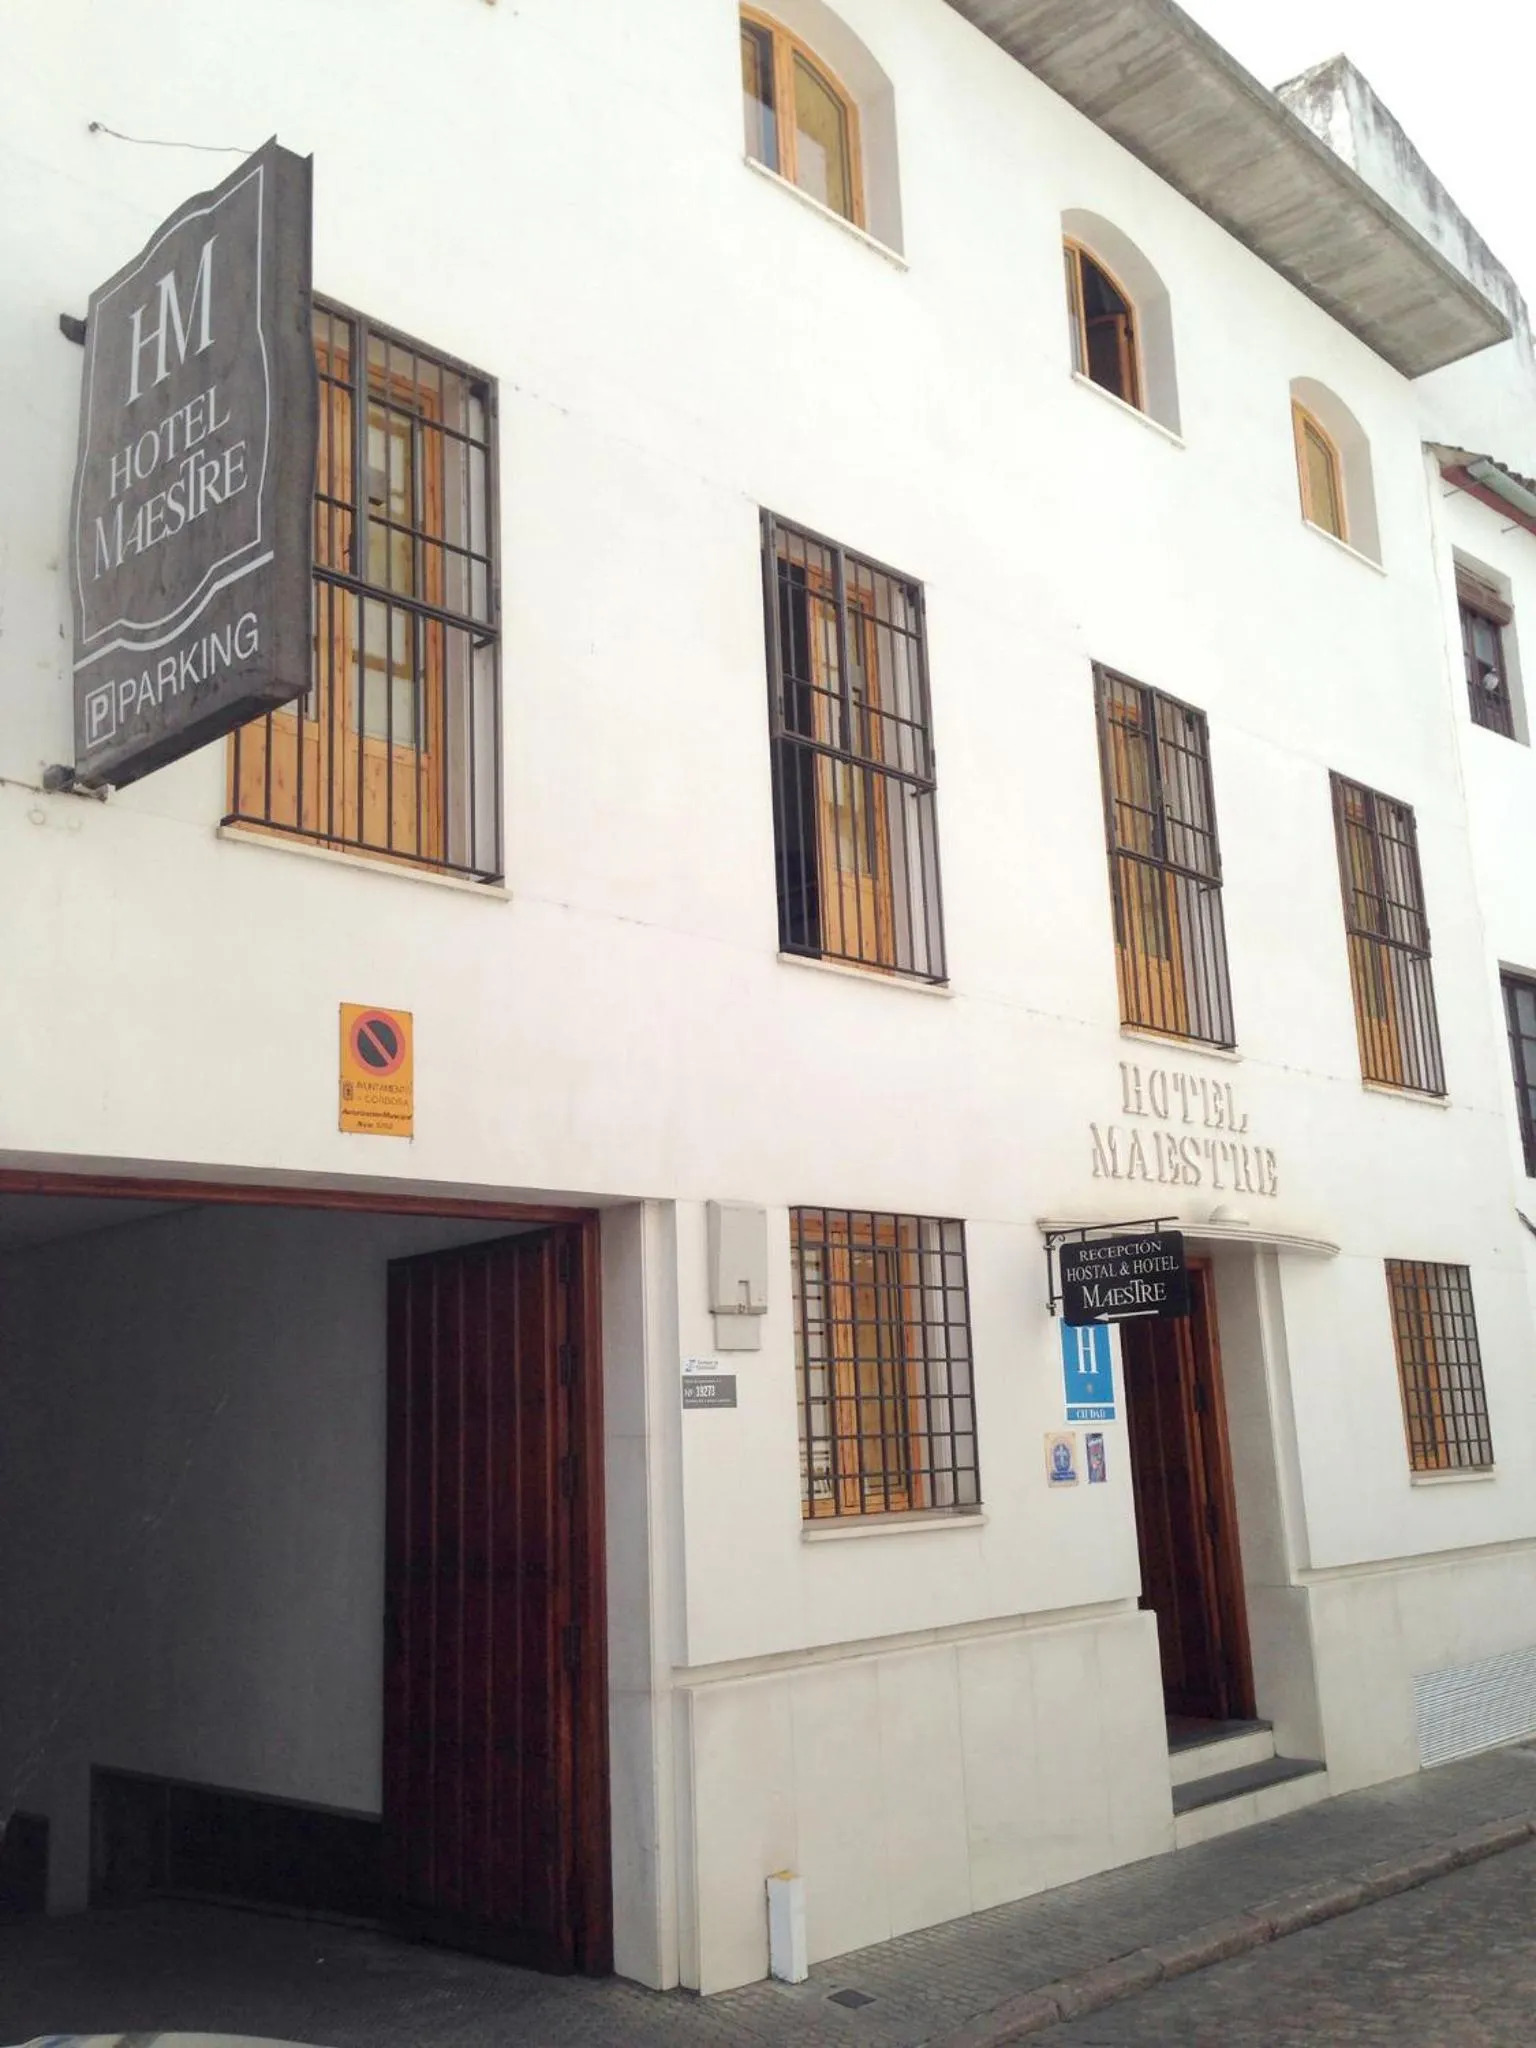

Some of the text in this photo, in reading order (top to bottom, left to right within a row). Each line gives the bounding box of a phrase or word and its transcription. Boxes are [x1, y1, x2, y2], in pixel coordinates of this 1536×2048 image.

[124, 234, 219, 407] HM
[110, 385, 231, 500] HOTEL
[92, 441, 248, 580] MAESTRE
[91, 612, 258, 738] P PARKING
[1119, 1061, 1249, 1133] HOTEL
[1089, 1122, 1278, 1197] MAESTRE
[1066, 1255, 1179, 1282] HOSTAL & HOTEL
[1079, 1239, 1163, 1262] RECEPCIÓN
[1082, 1279, 1167, 1309] MAESTRE
[1074, 1326, 1099, 1374] H
[1076, 1408, 1106, 1420] CIUDAD
